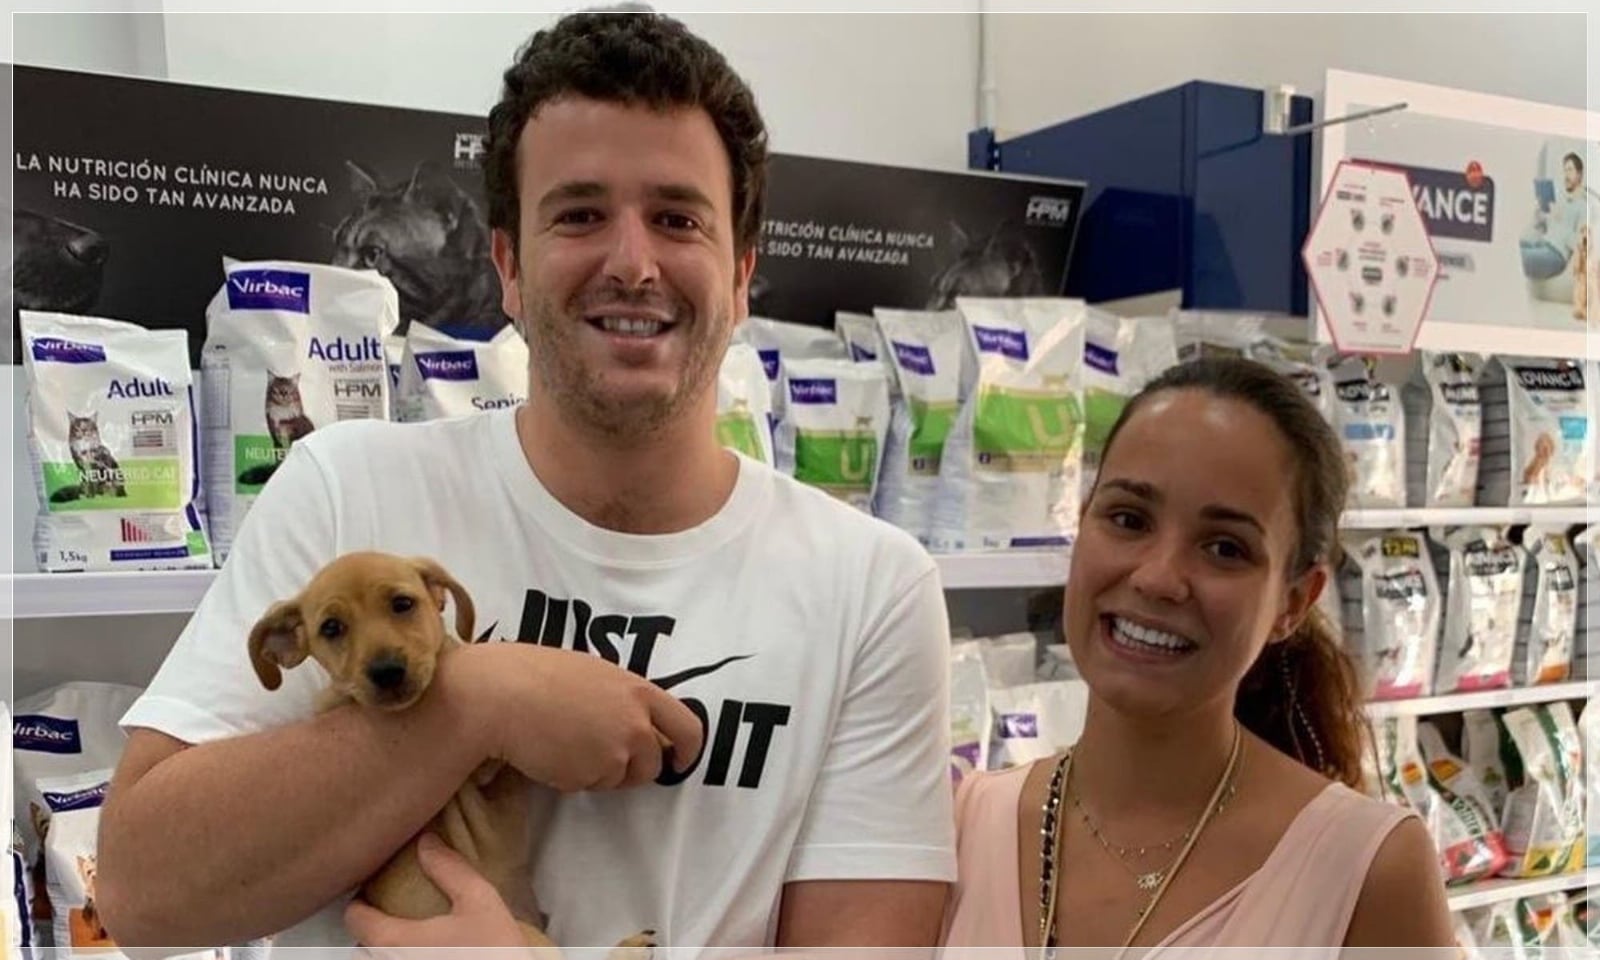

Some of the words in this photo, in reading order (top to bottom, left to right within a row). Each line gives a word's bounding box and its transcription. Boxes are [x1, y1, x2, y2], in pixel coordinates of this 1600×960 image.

[16, 153, 41, 171] LA
[49, 155, 166, 181] NUTRICIÓN
[174, 163, 253, 188] CLÍNICA
[259, 173, 328, 194] NUNCA
[54, 180, 82, 199] HA
[88, 183, 138, 202] SIDO
[146, 187, 185, 207] TAN
[192, 192, 295, 215] AVANZADA
[761, 219, 824, 240] TRICIÓN
[828, 223, 882, 245] CLÍNICA
[885, 231, 934, 249] NUNCA
[767, 241, 802, 257] SIDO
[807, 244, 834, 260] TAN
[837, 247, 909, 266] AVANZADA
[232, 277, 304, 298] Virbac
[308, 336, 382, 361] Adult
[419, 358, 473, 371] Virbac
[107, 377, 174, 400] Adult
[333, 383, 382, 397] HPM
[131, 412, 173, 426] HPM
[703, 698, 791, 789] IT
